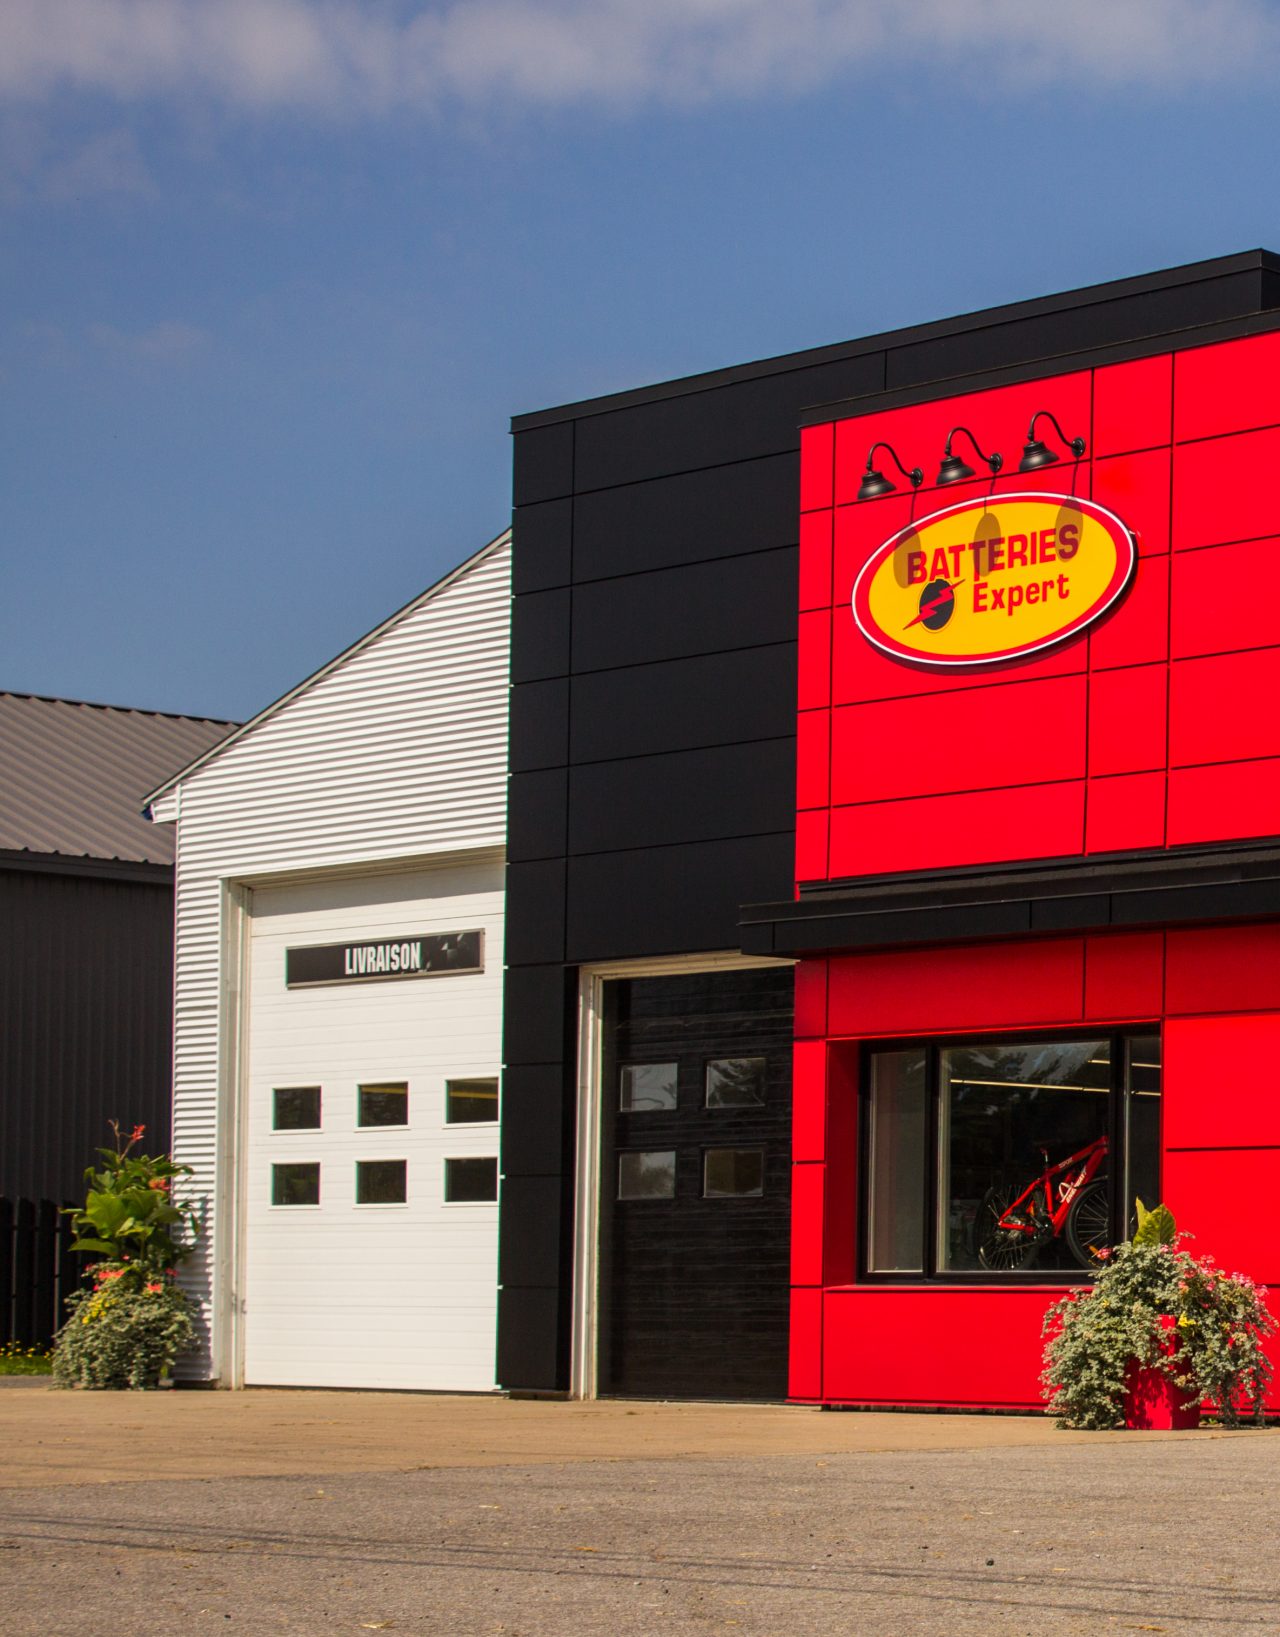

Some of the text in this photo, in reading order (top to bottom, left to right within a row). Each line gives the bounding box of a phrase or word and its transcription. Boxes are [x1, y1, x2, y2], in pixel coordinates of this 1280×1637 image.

[907, 523, 1079, 585] BATTERIES
[972, 573, 1070, 616] Expert
[344, 942, 421, 975] LIVRAISON
